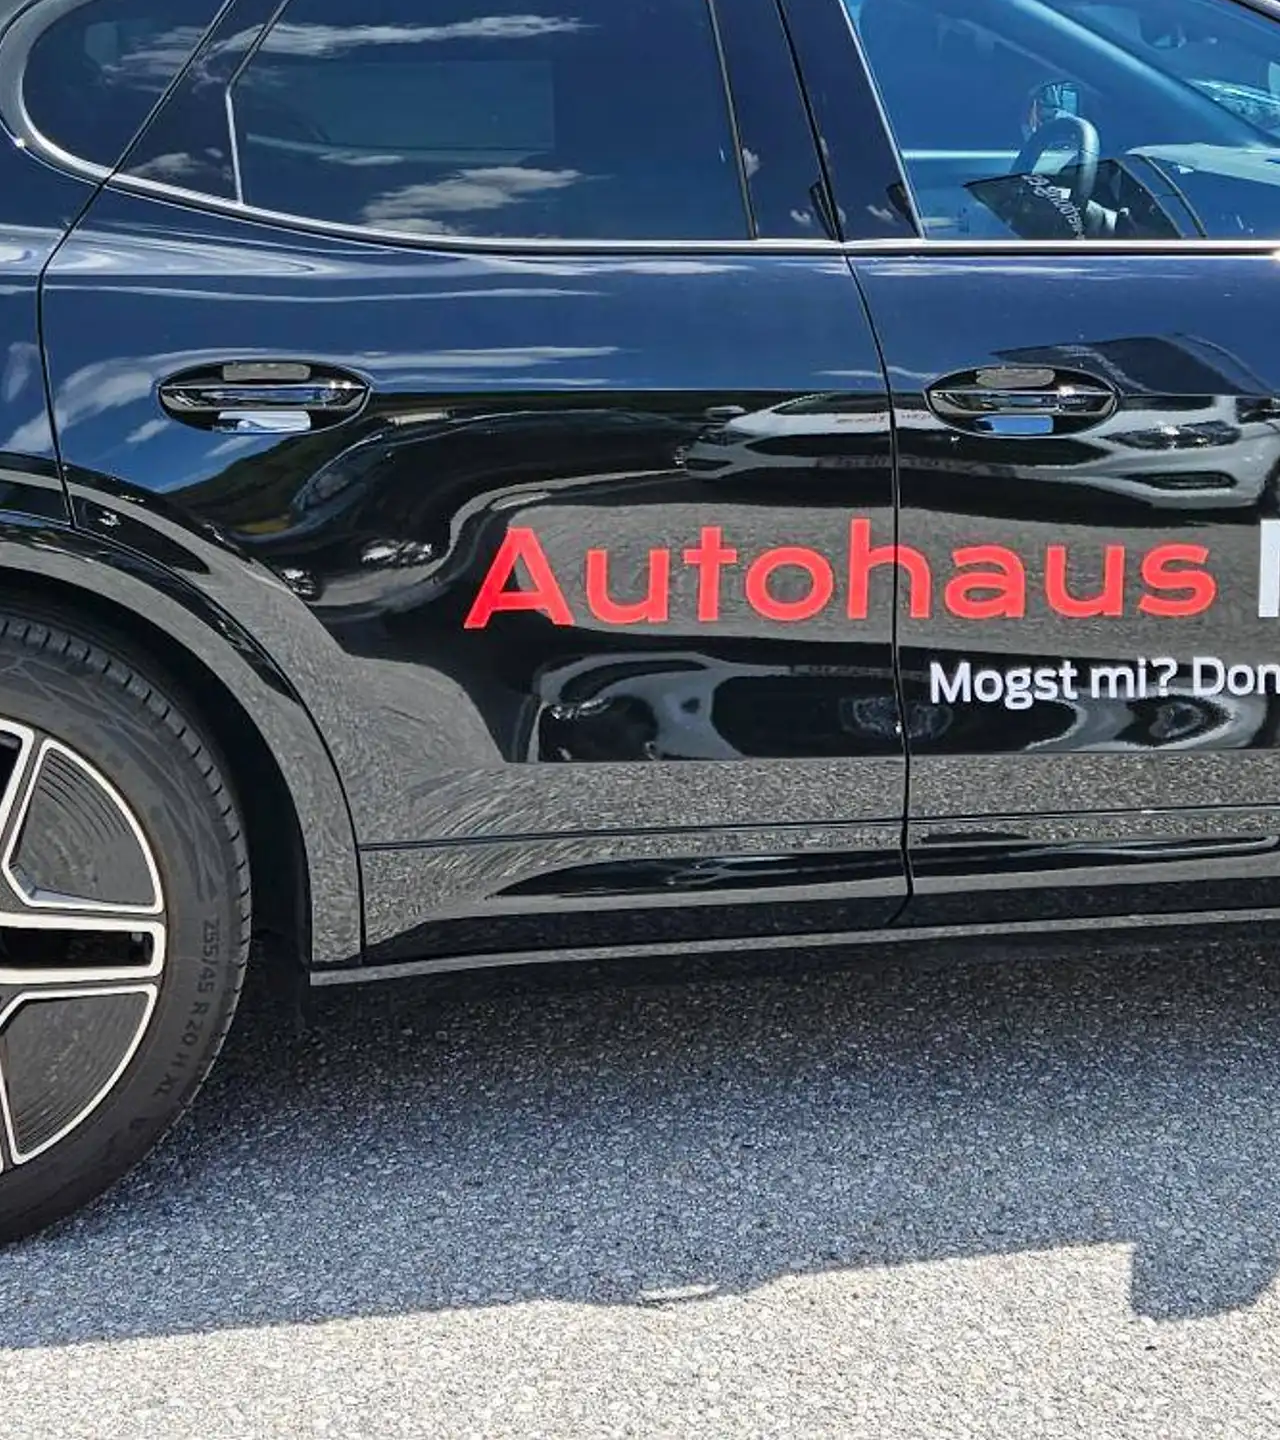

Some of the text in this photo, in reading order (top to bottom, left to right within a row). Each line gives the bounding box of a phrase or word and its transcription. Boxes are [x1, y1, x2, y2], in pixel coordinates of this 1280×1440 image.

[463, 516, 1217, 630] Autohaus
[929, 659, 1078, 710] Mogst
[1090, 658, 1175, 698] mi?
